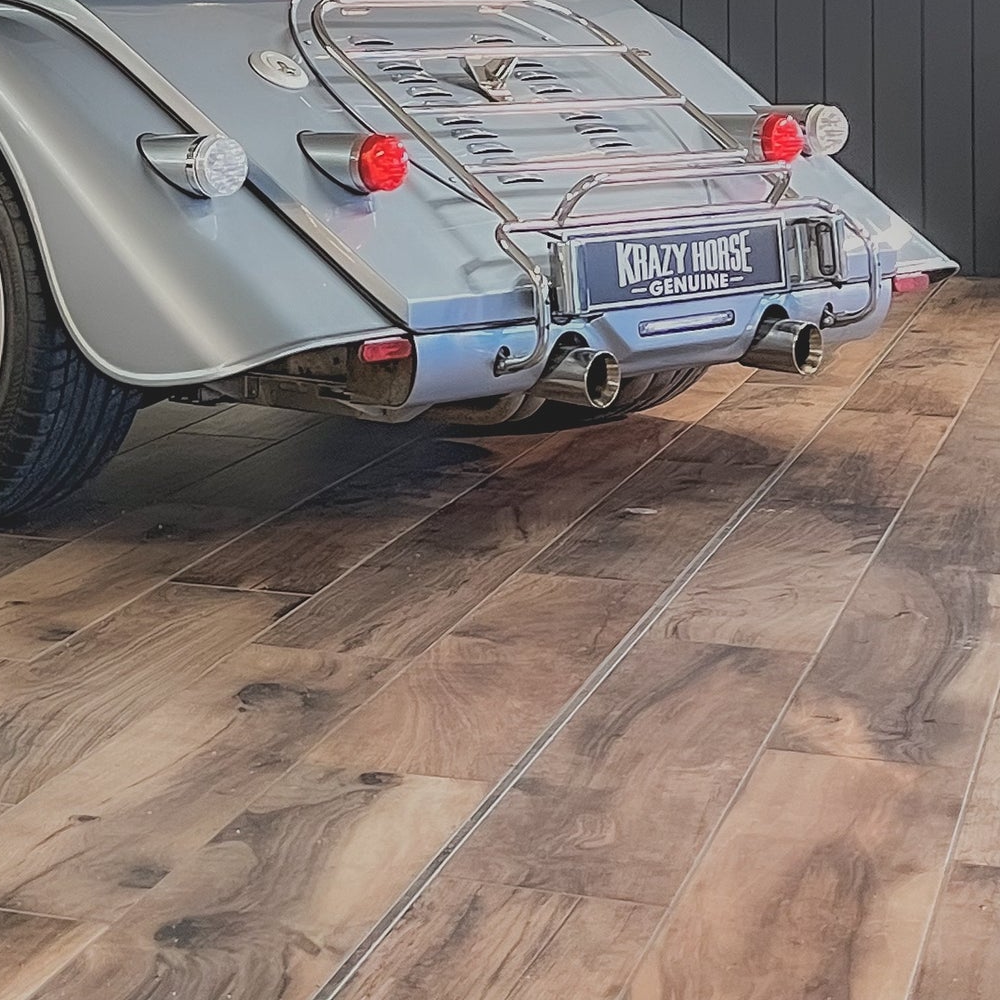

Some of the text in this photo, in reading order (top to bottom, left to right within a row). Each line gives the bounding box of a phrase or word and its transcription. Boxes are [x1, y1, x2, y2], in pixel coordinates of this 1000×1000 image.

[616, 230, 752, 288] KRAZY HORSE
[649, 273, 729, 296] GENUINE
